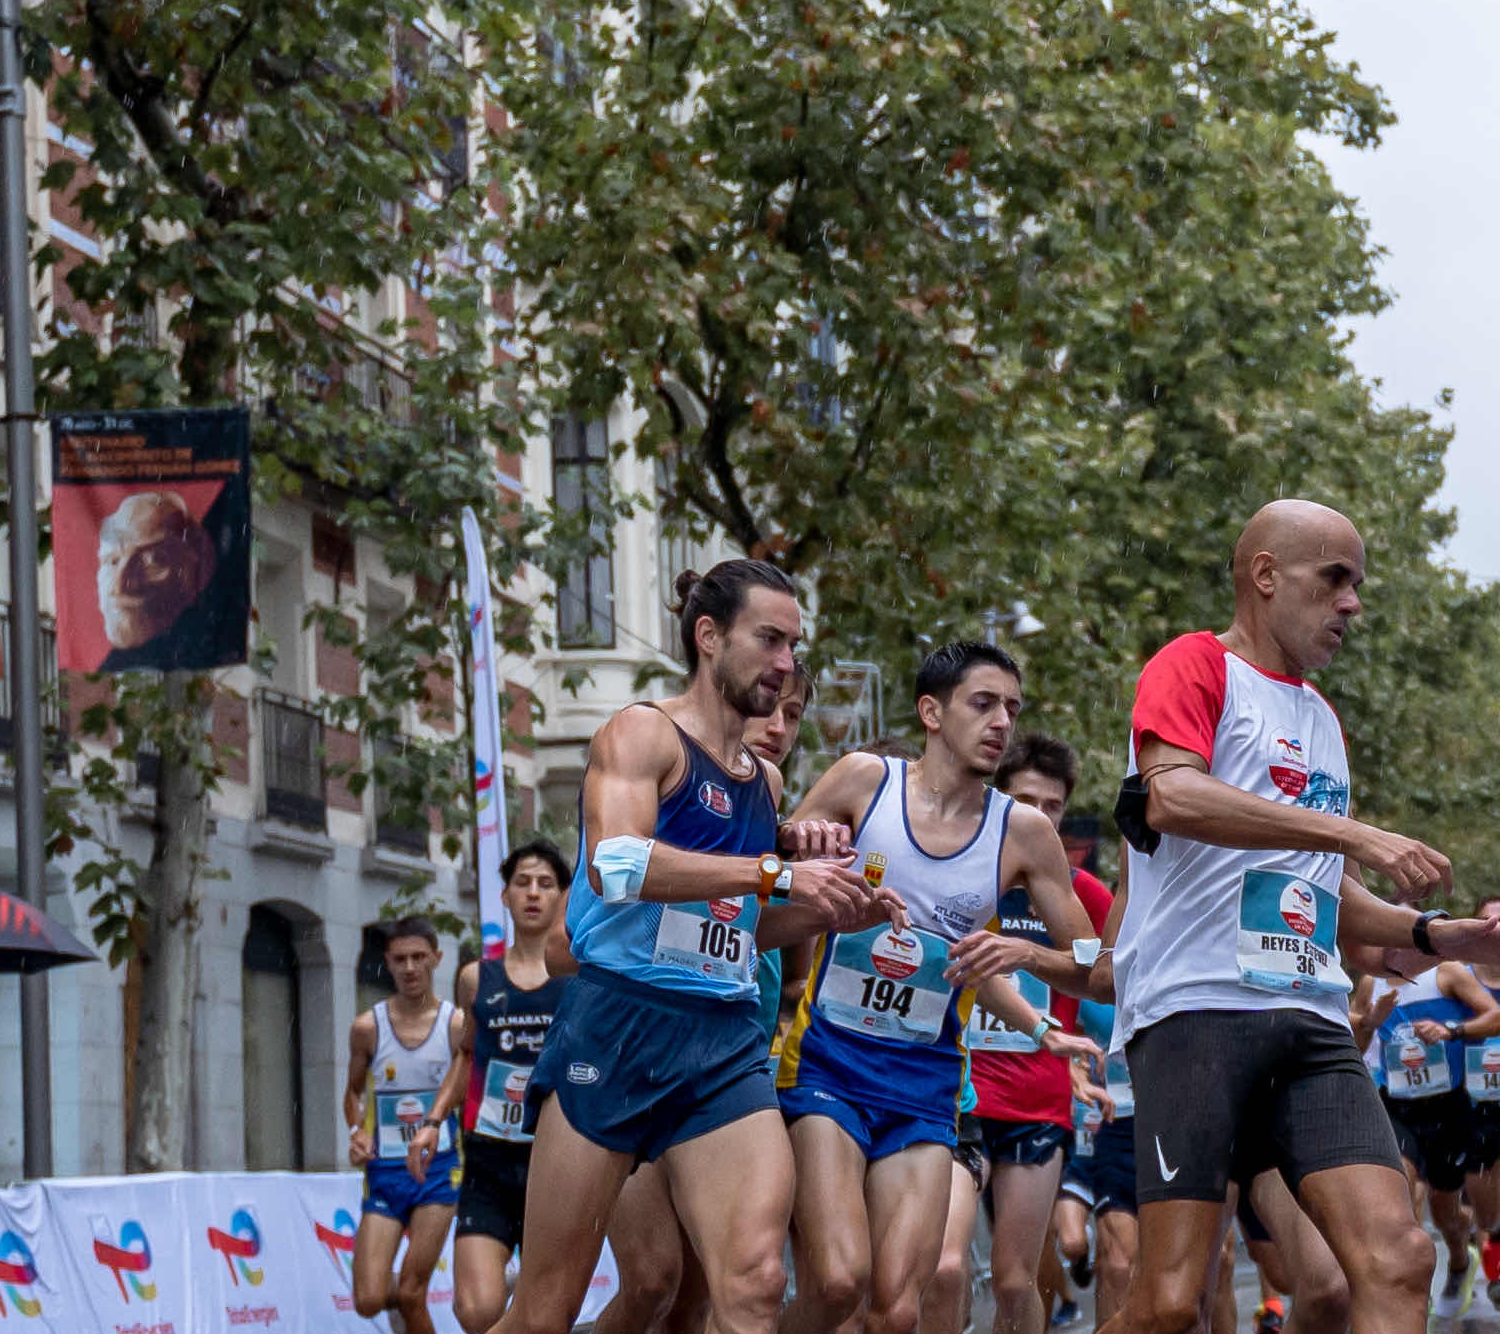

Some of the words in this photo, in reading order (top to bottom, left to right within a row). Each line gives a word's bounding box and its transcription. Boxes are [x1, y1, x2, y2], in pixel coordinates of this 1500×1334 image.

[698, 919, 741, 963] 105
[1261, 935, 1301, 954] REYES
[1296, 954, 1316, 977] 36
[861, 976, 916, 1018] 194
[1404, 1067, 1431, 1087] 151
[502, 1103, 523, 1125] 10
